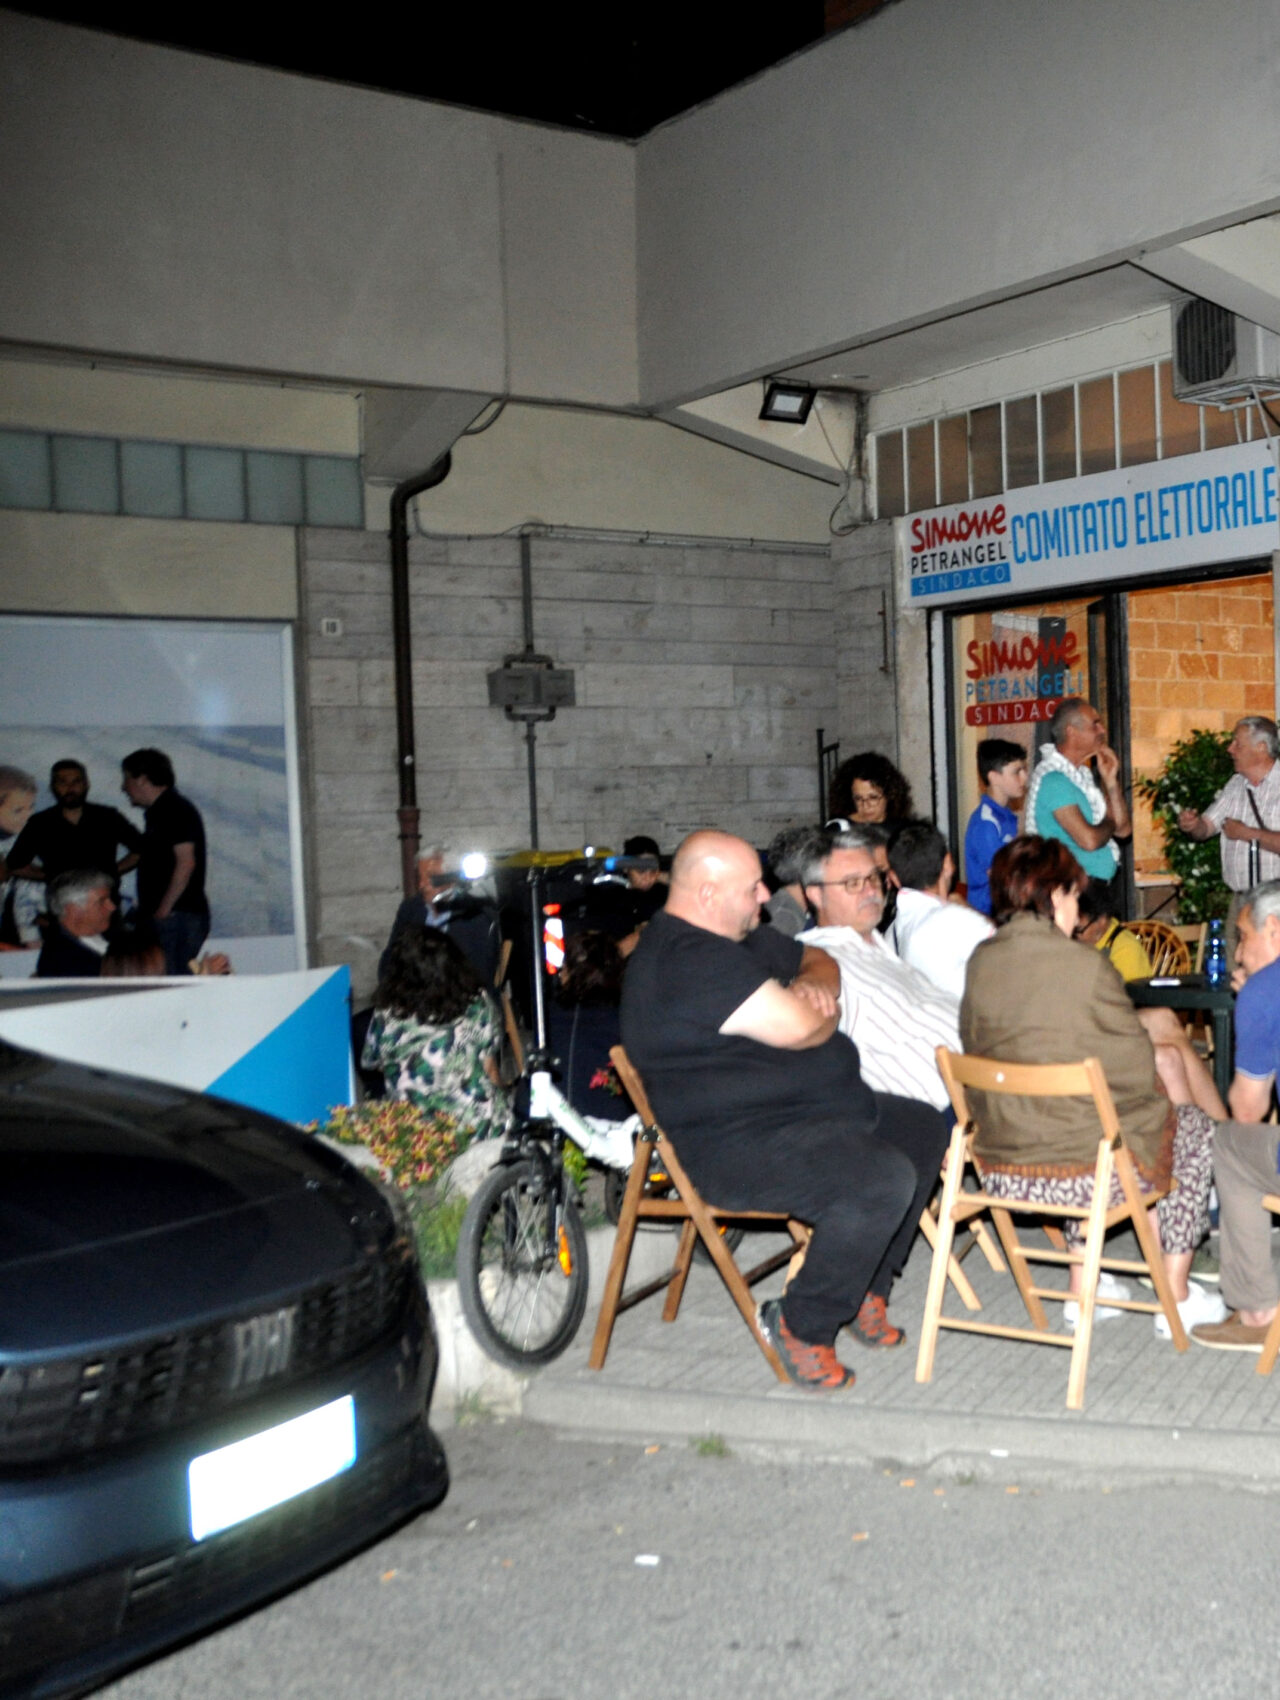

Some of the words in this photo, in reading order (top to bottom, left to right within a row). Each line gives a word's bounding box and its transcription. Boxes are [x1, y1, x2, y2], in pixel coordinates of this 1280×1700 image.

[1011, 496, 1128, 565] COMITATO
[1134, 466, 1277, 546] ELETTORALE
[918, 565, 1006, 594] SINDACO
[965, 671, 1084, 703] PETRANGELI
[974, 700, 1057, 724] SINDAC
